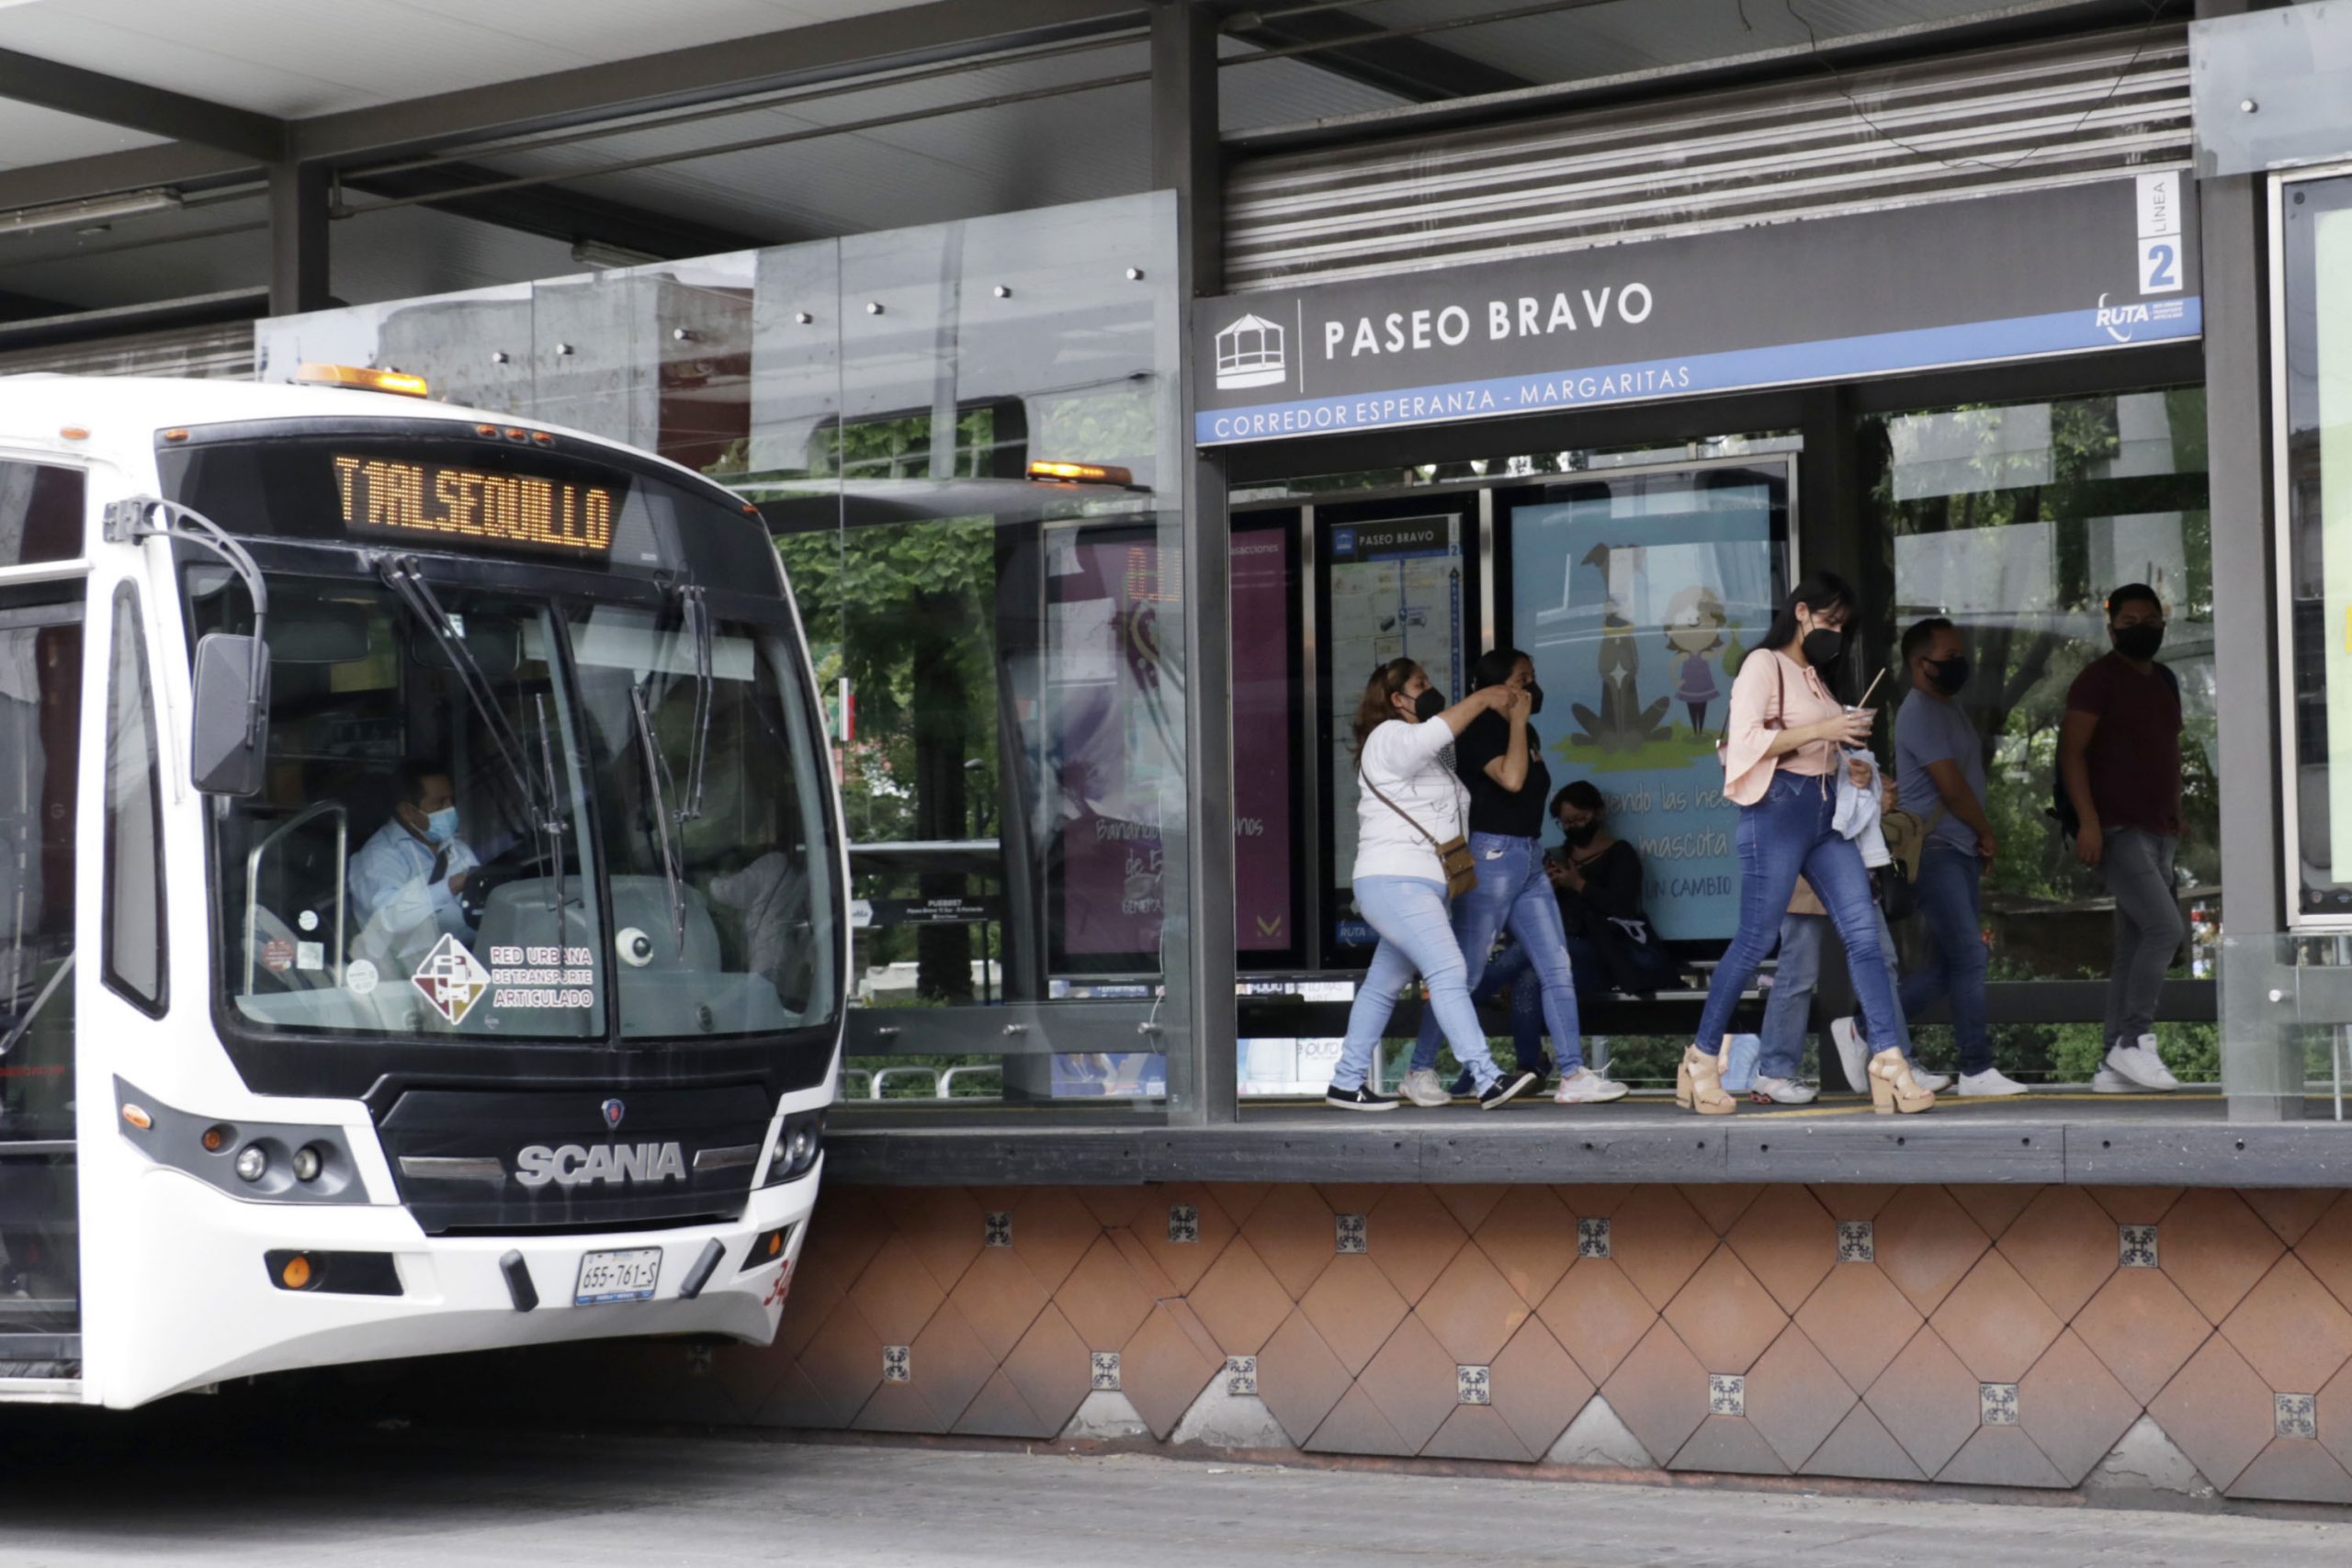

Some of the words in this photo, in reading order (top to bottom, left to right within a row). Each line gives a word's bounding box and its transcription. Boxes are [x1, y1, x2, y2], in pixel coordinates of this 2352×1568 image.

[2148, 243, 2175, 288] 2
[1325, 305, 1470, 360] PASEO
[1488, 282, 1653, 341] BRAVO
[2096, 304, 2149, 327] RUTA
[1215, 405, 1347, 438] CORREDOR
[1356, 389, 1495, 423] ESPERANZA
[1521, 366, 1690, 405] MARGARITAS
[1359, 534, 1394, 547] PASEO
[1396, 530, 1434, 543] BRAVO
[1661, 783, 1688, 810] las
[1638, 826, 1728, 858] mascota
[1670, 876, 1732, 898] CAMBIO
[1340, 927, 1366, 937] RUTA
[491, 946, 524, 964] RED
[526, 947, 593, 964] URBANA
[492, 969, 511, 984] DE
[514, 969, 593, 985] TRANSPORTE
[493, 989, 594, 1008] ARTICULADO
[515, 1142, 686, 1185] SCANIA
[582, 1262, 658, 1289] 655-761-S
